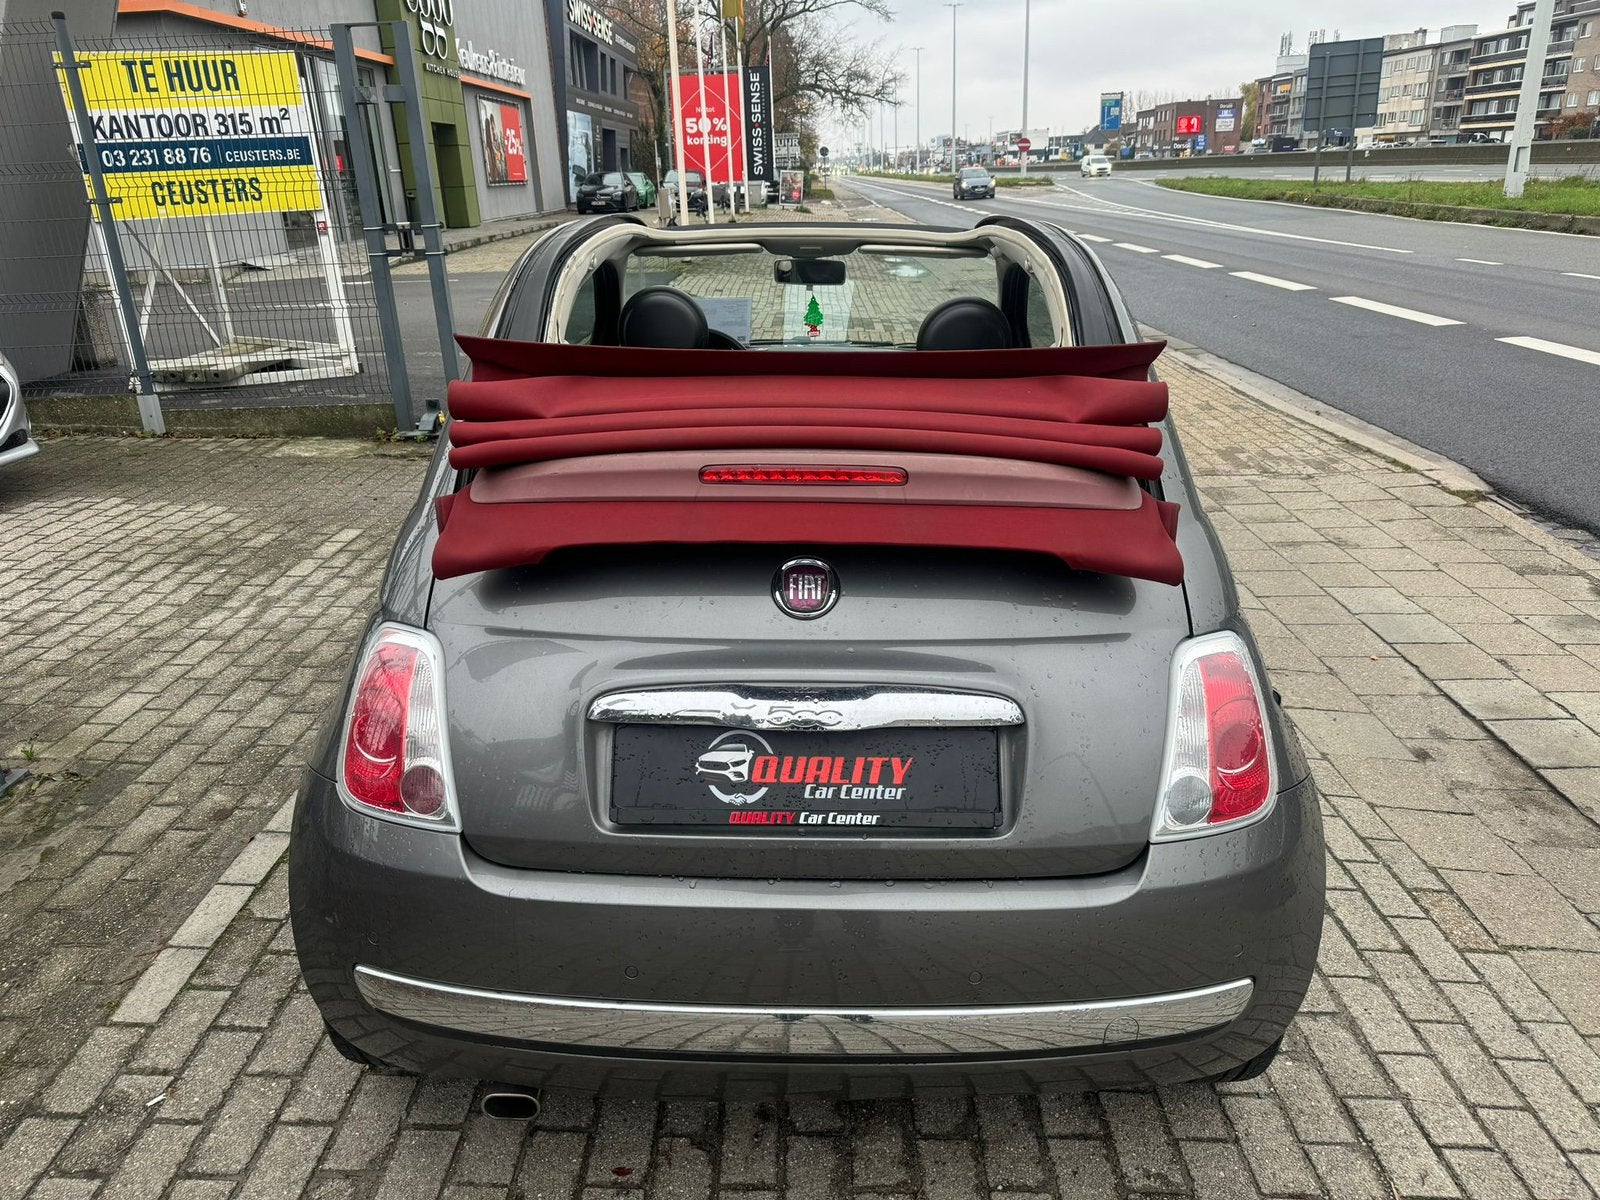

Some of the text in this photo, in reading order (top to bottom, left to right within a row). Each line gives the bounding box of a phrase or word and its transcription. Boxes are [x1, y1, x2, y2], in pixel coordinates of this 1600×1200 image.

[568, 0, 592, 33] SWISS
[593, 10, 613, 46] SENSE
[121, 59, 240, 93] TE HUUR
[750, 72, 762, 123] SENSE
[89, 112, 209, 140] KANTOOR
[214, 112, 254, 137] 315
[101, 147, 301, 168] 03 231 88 76 CEUSTERS.BE
[752, 128, 764, 175] SWISS
[151, 177, 264, 207] CEUSTERS
[789, 574, 825, 600] FIAT
[767, 705, 844, 728] 500
[751, 755, 915, 785] QUALITY
[804, 784, 906, 800] Car Center
[729, 811, 880, 825] QUALITY Car Center
